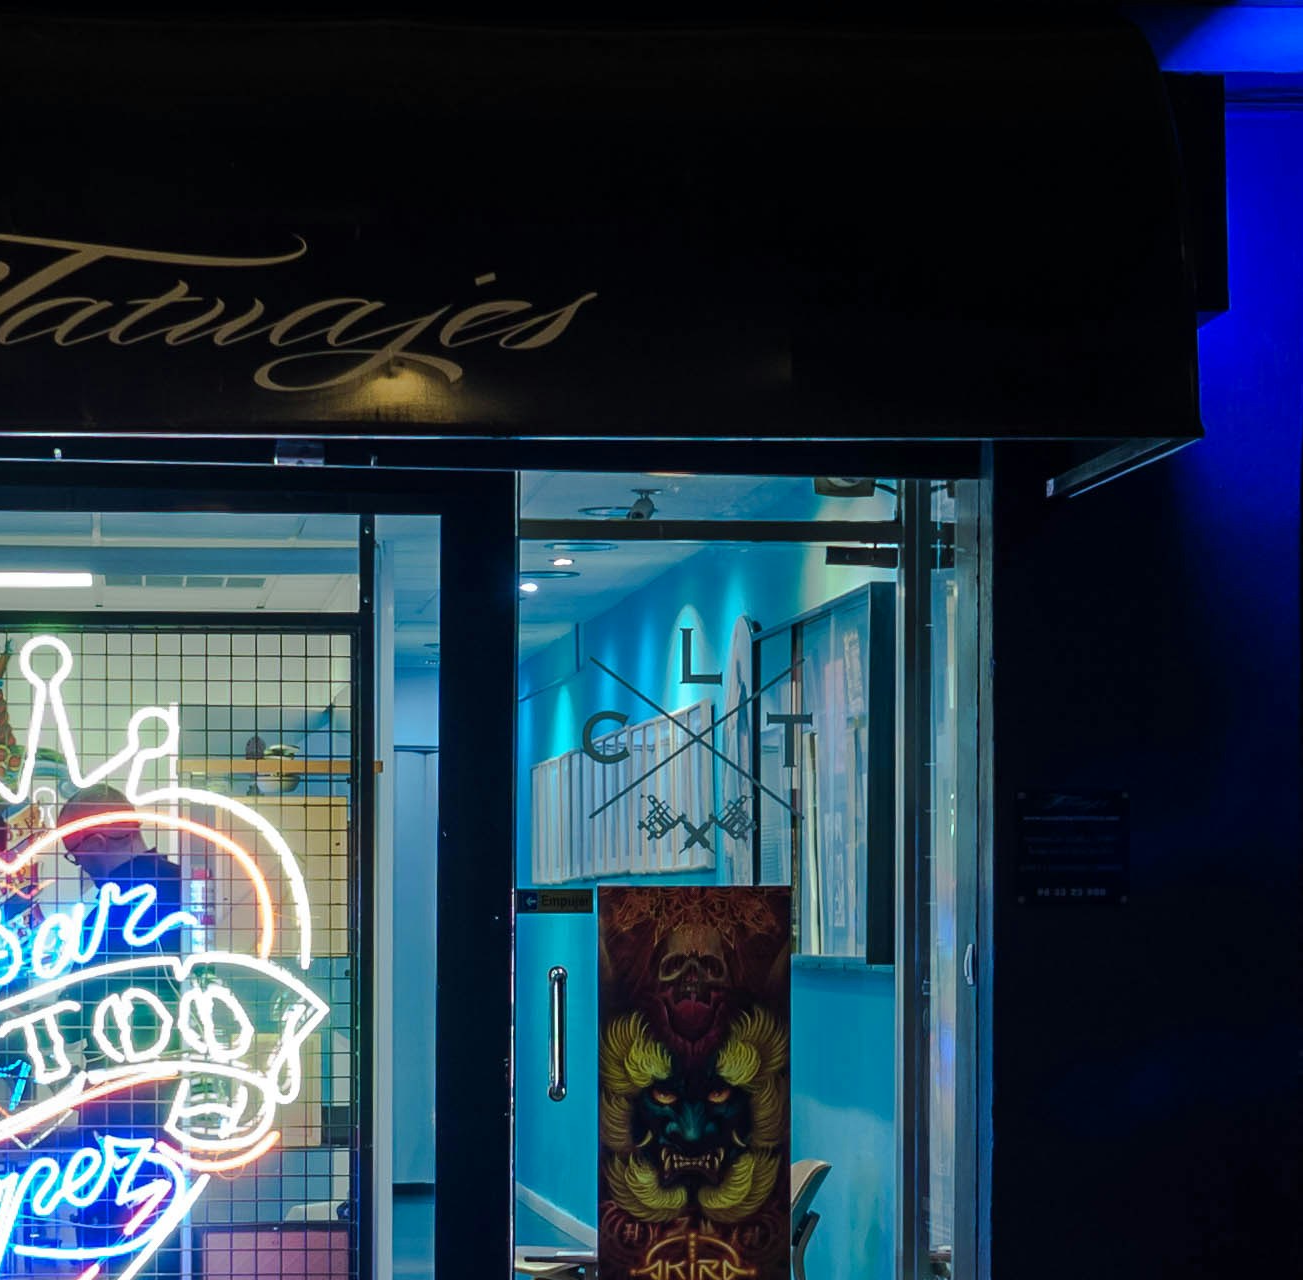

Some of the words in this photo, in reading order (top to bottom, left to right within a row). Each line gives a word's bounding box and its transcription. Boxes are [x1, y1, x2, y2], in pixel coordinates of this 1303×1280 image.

[679, 627, 723, 686] L
[582, 710, 630, 764] C
[766, 711, 813, 768] T
